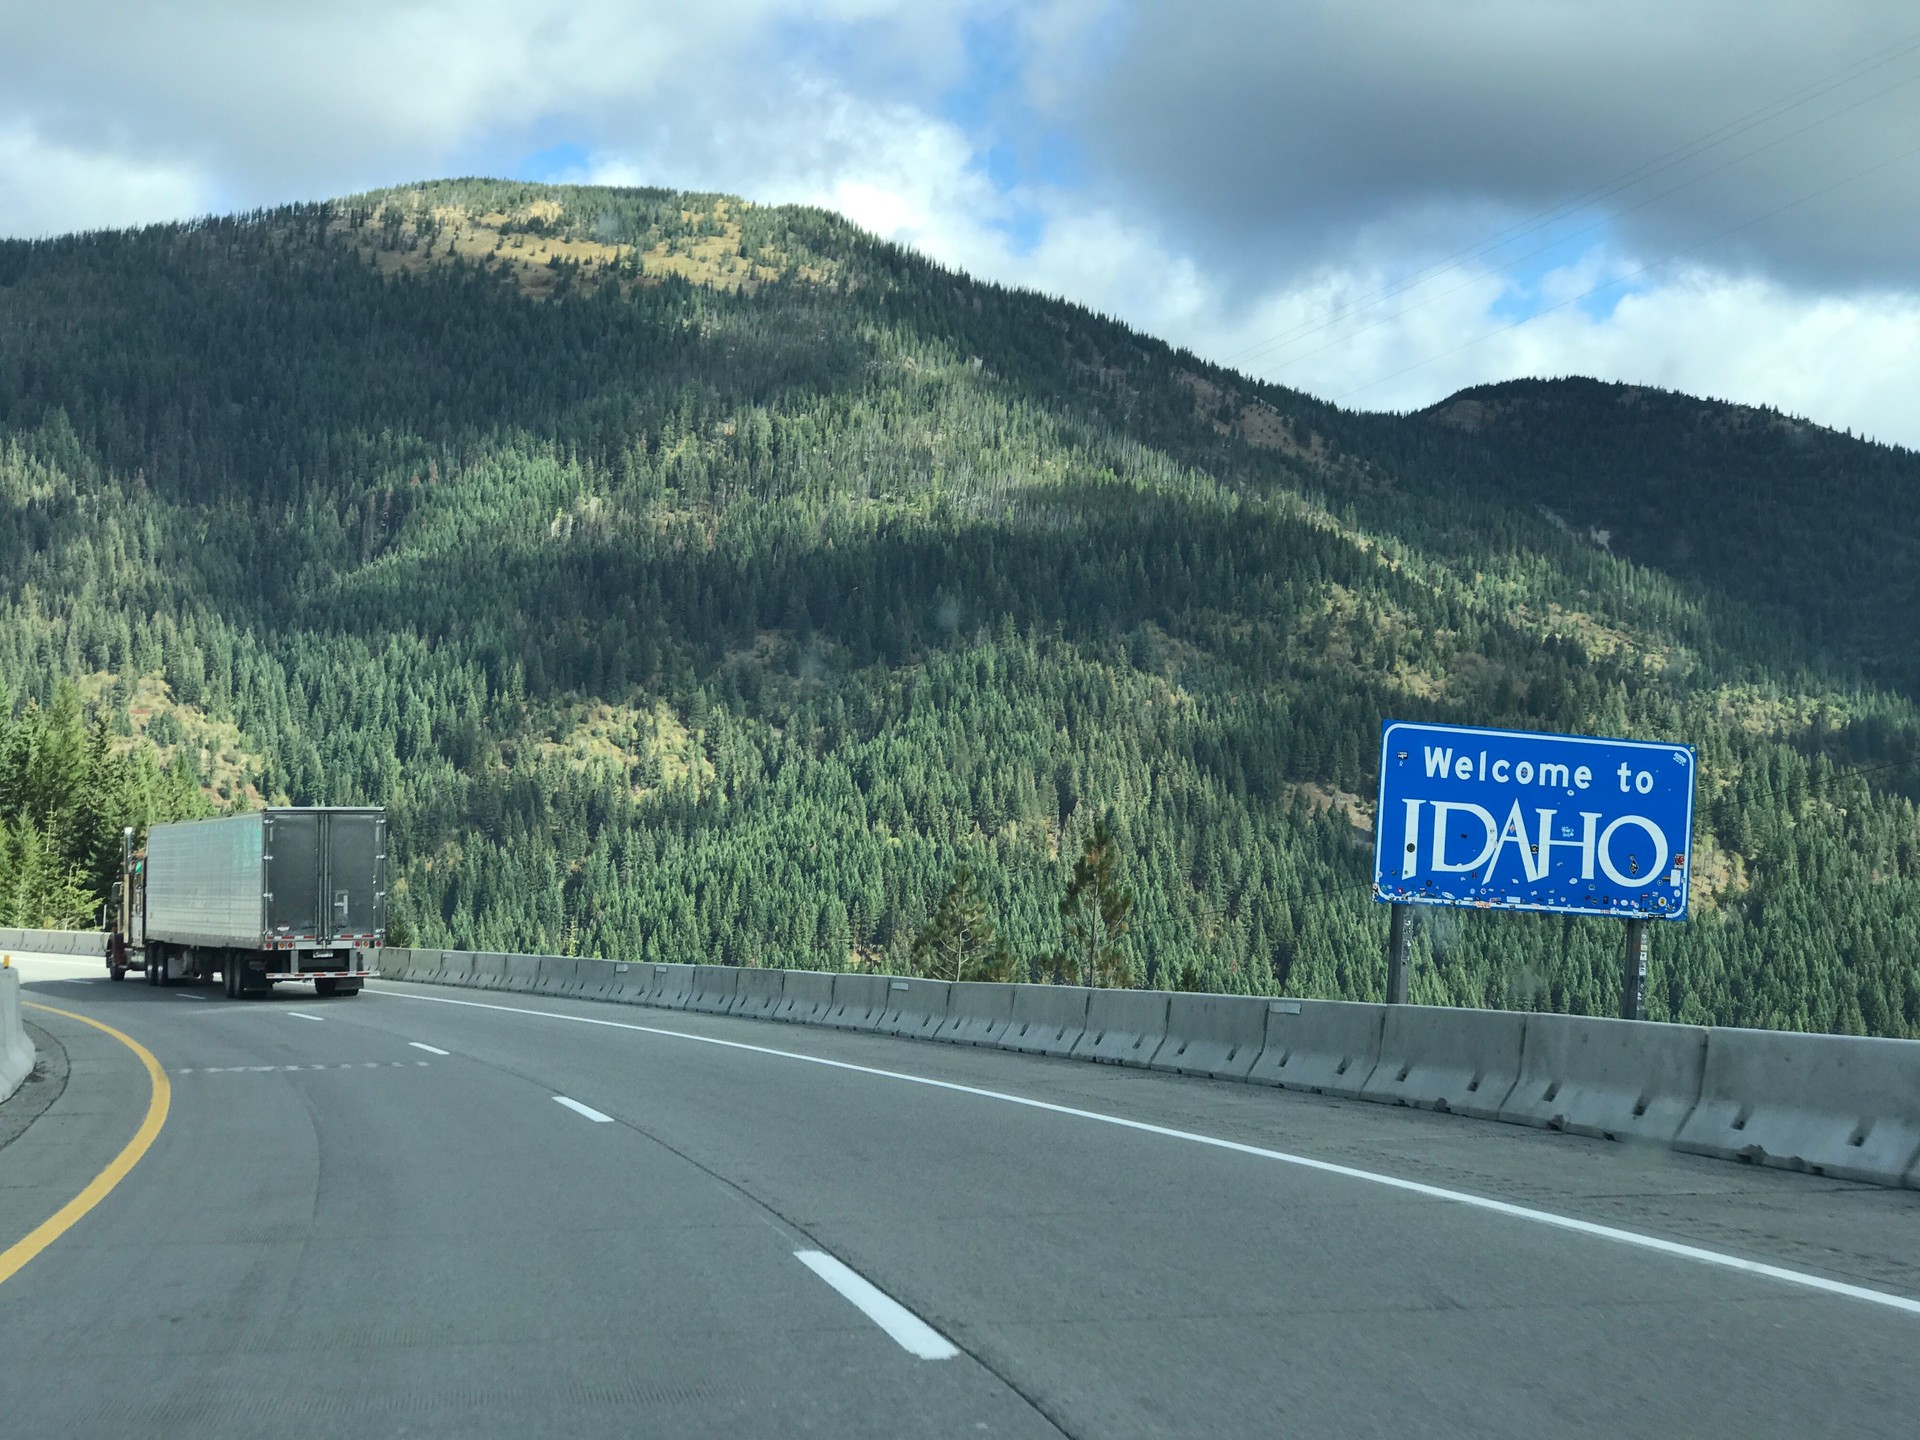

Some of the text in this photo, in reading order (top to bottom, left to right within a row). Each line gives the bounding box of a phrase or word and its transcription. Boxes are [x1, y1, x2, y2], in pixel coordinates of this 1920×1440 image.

[1424, 746, 1654, 794] Welcome to
[1402, 797, 1668, 887] IDAHO
